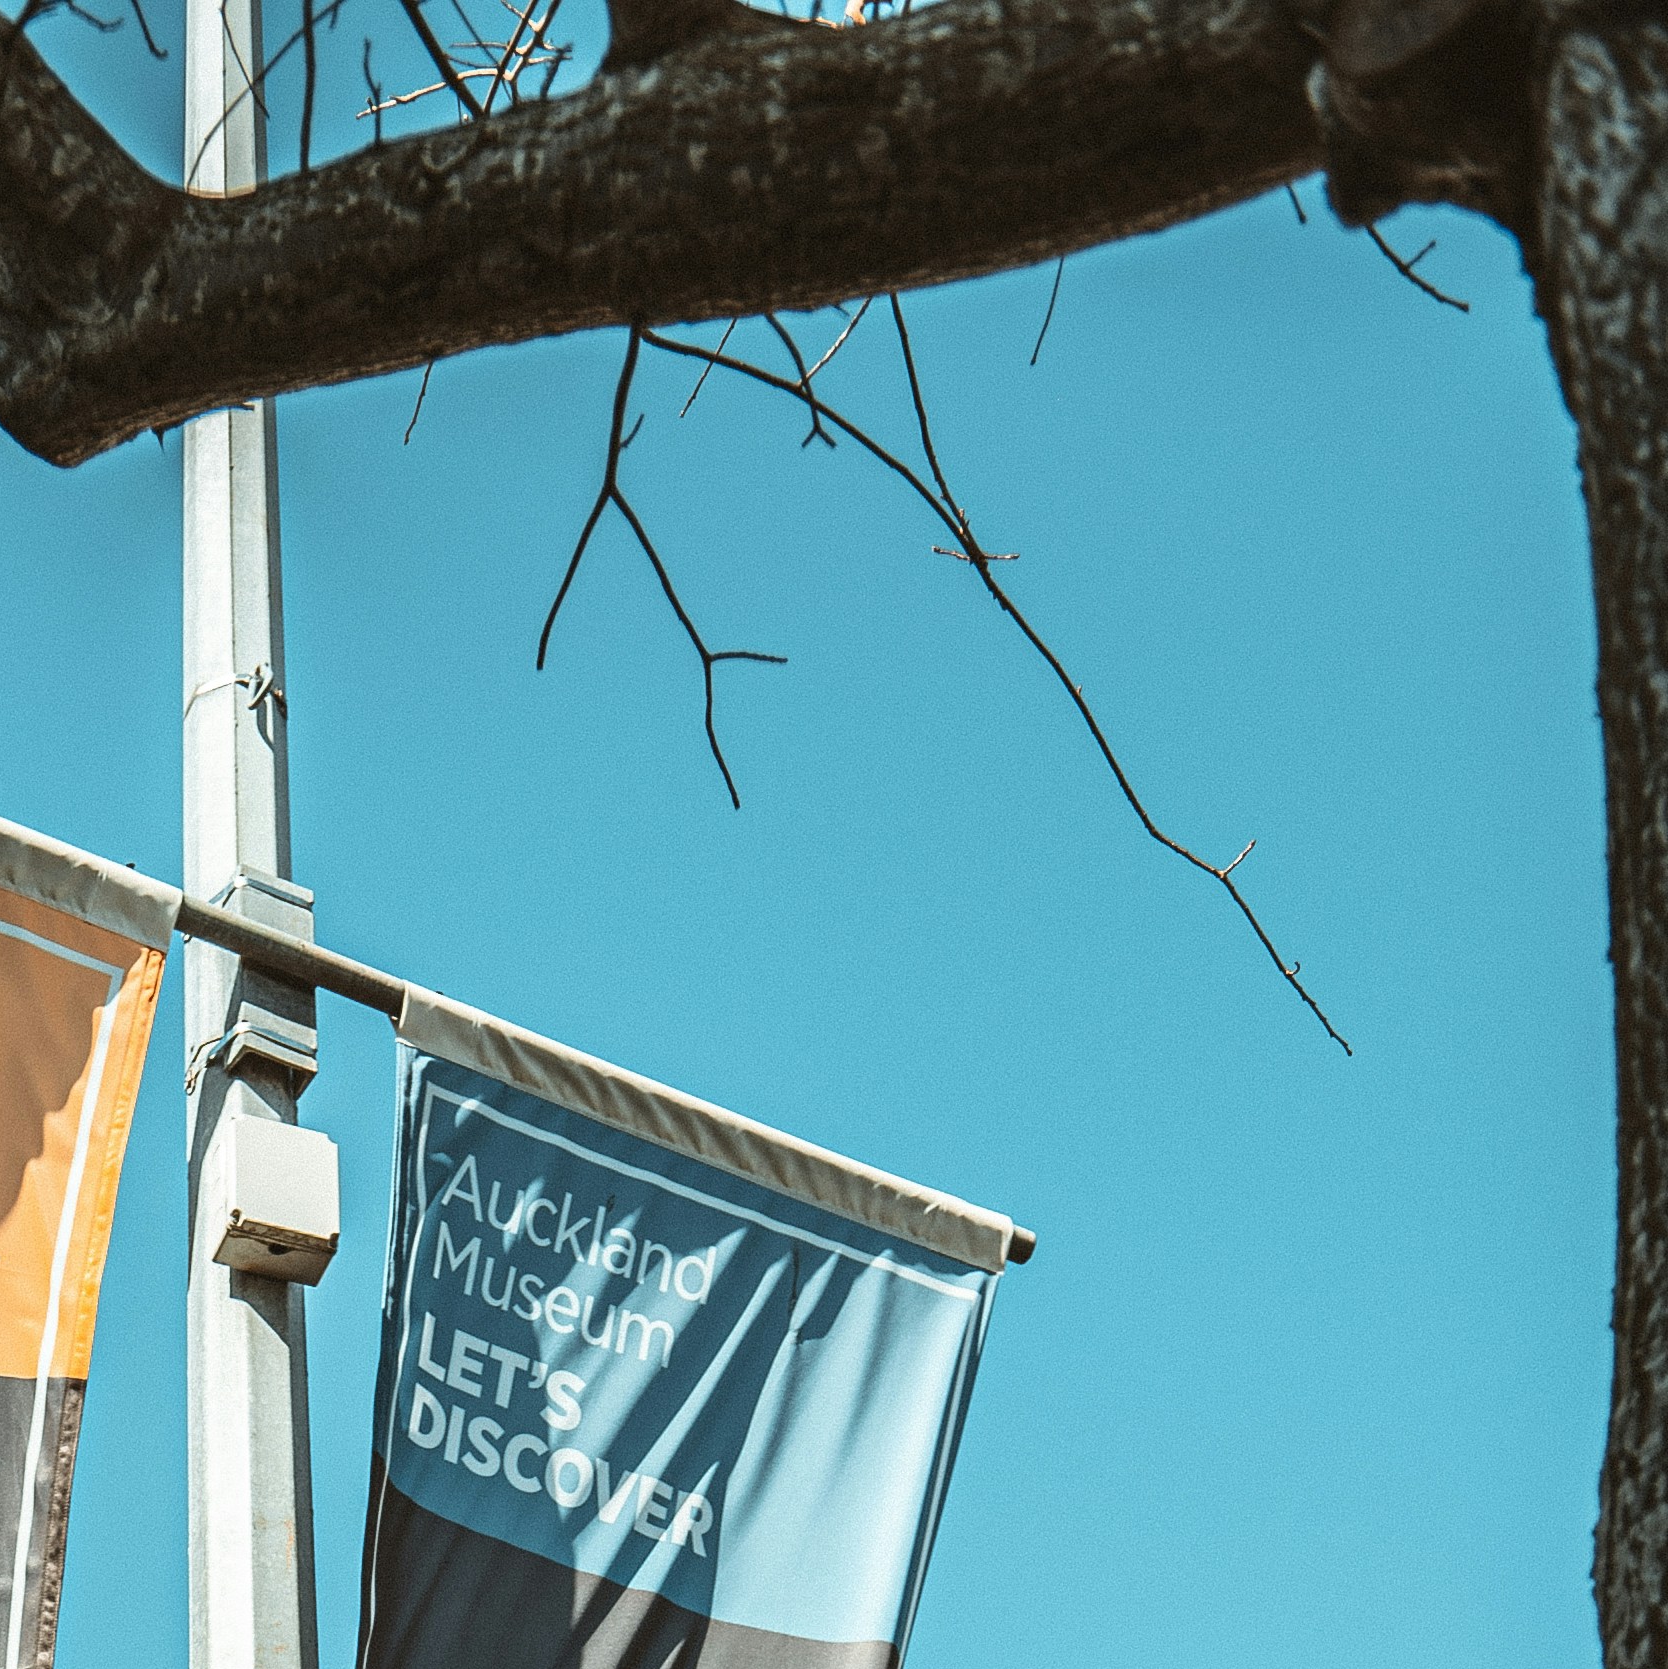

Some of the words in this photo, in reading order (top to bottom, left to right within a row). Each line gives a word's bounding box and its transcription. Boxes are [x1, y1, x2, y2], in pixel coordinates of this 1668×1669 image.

[432, 1220, 676, 1368] Museum
[440, 1154, 718, 1305] Auckland
[418, 1310, 588, 1432] LET'S
[407, 1382, 715, 1557] DISCOVER
